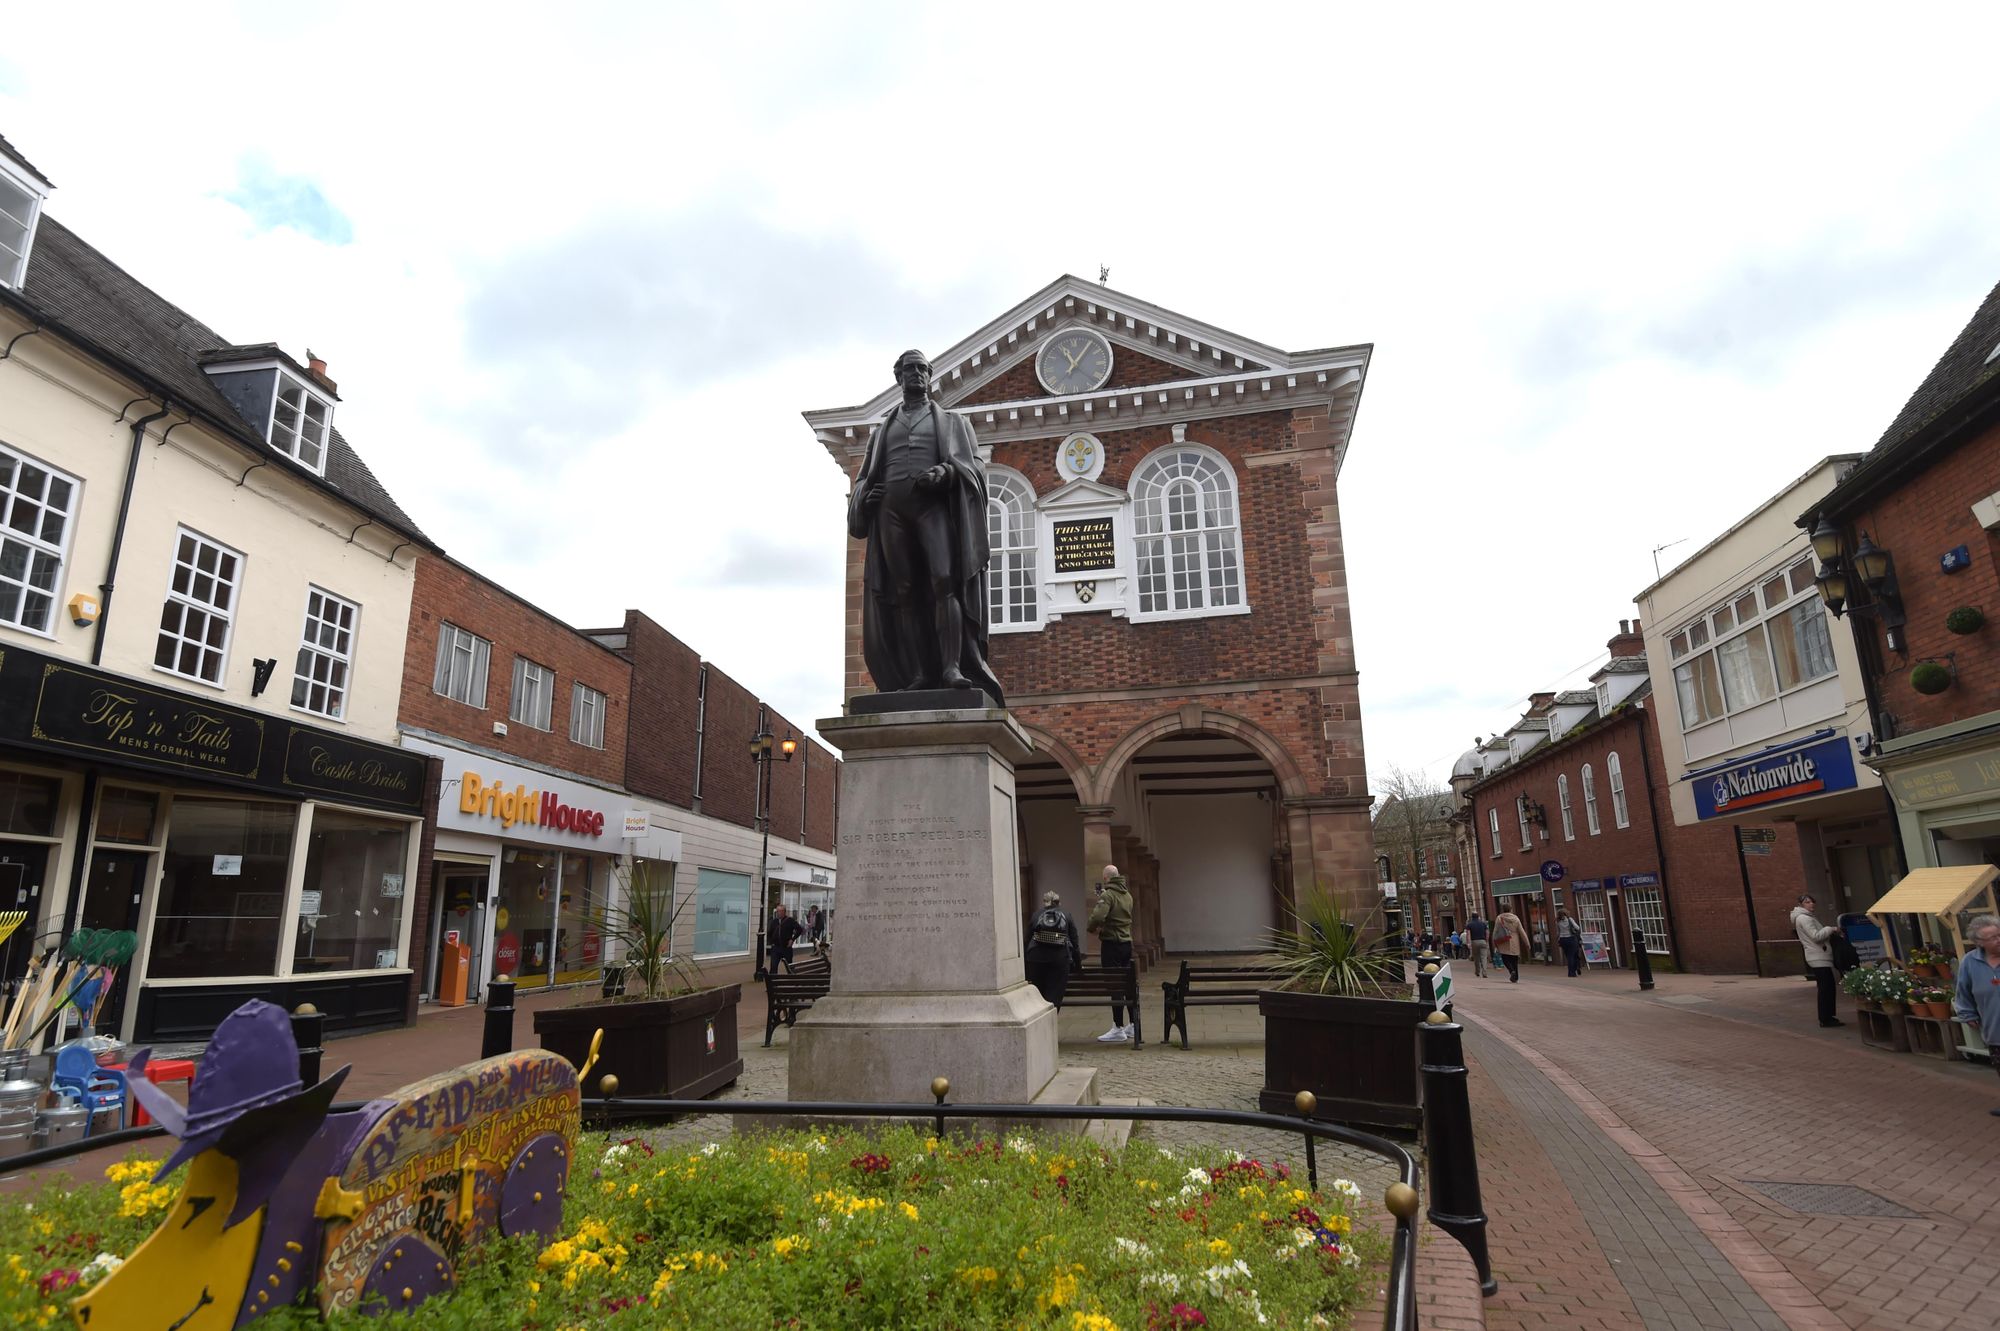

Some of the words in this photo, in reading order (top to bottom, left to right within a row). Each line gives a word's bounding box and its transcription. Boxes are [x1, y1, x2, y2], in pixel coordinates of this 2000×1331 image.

[1054, 527, 1081, 535] THIS
[1084, 524, 1111, 533] HALL
[1082, 542, 1113, 550] CHARGE
[82, 688, 138, 741] Top
[178, 710, 231, 751] Tails
[119, 735, 150, 750] MENS
[153, 743, 196, 759] FORMAL
[199, 751, 227, 765] WEAR
[309, 746, 356, 781] Castle
[359, 759, 407, 791] Brides
[1727, 752, 1816, 798] Nationwide
[841, 834, 863, 846] SIR
[867, 831, 916, 844] ROBERT
[952, 908, 981, 919] DEATH
[363, 1079, 476, 1181] BREAD
[478, 1066, 505, 1090] FOR
[367, 1154, 421, 1203] VISIT
[425, 1147, 453, 1176] THE
[452, 1112, 502, 1173] PEEL
[500, 1096, 557, 1137] MUSEUM
